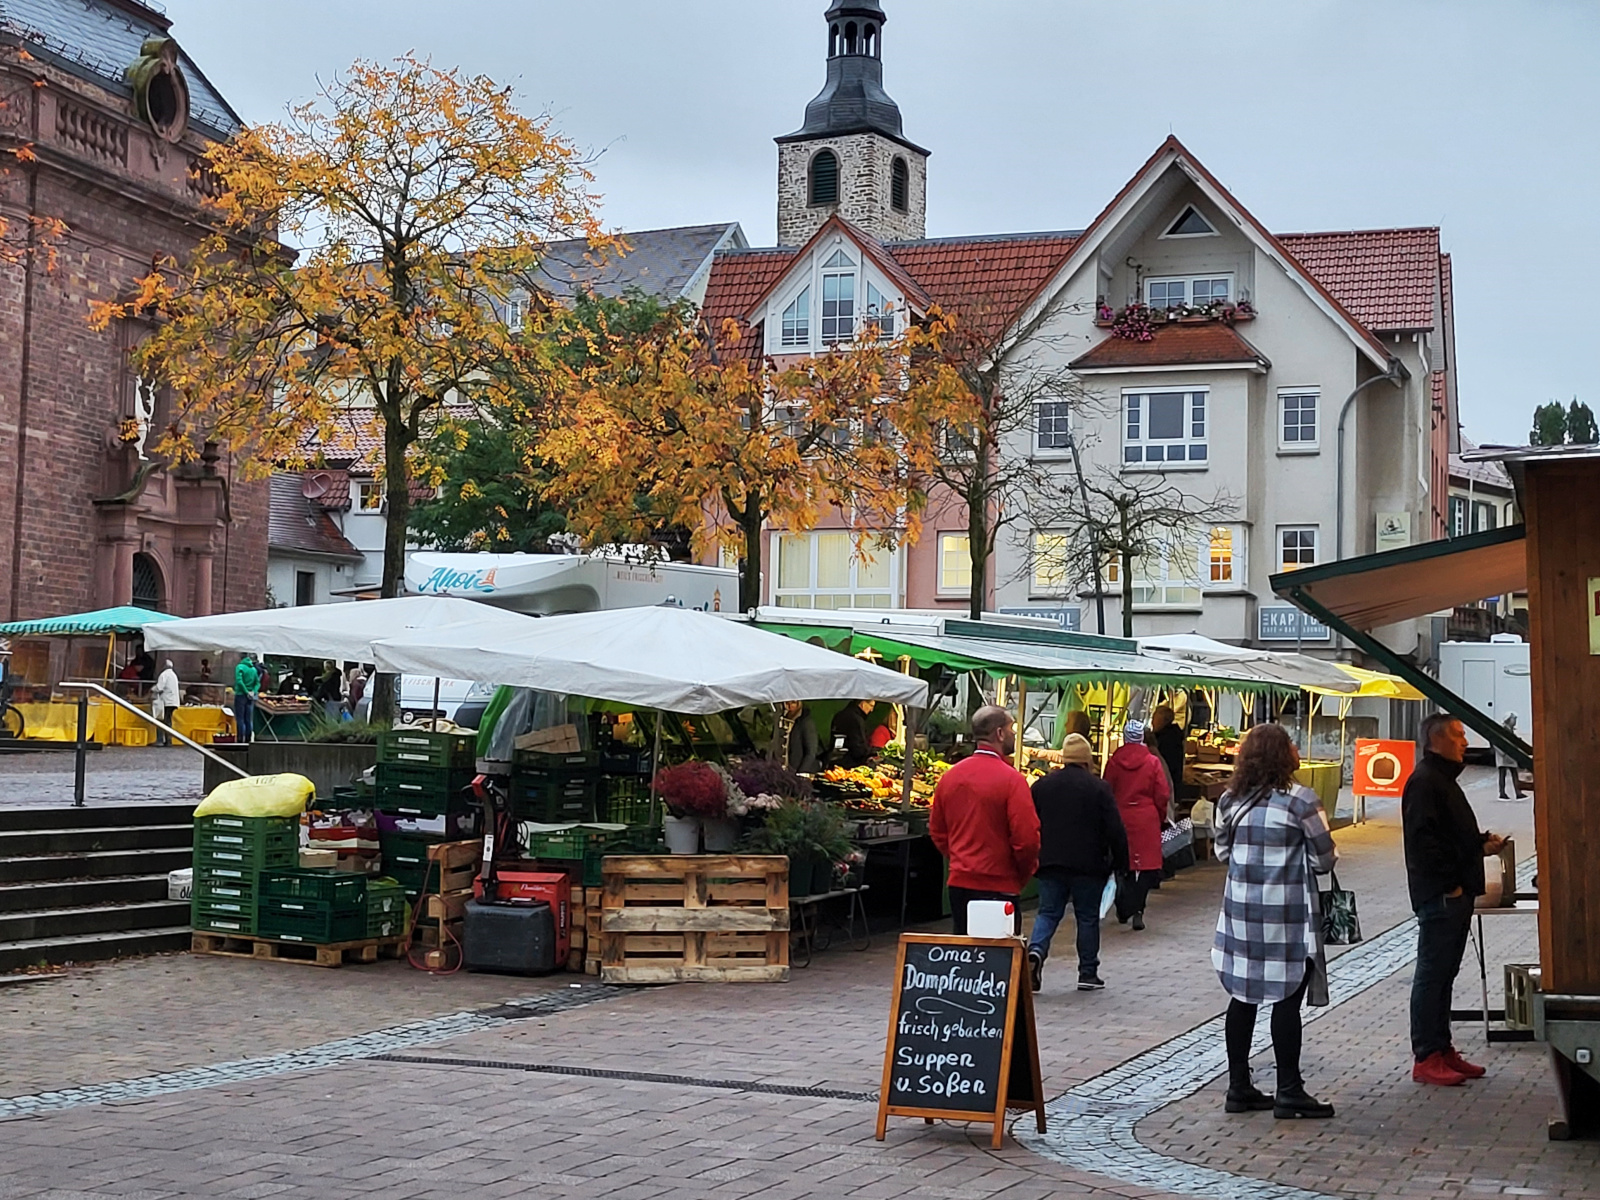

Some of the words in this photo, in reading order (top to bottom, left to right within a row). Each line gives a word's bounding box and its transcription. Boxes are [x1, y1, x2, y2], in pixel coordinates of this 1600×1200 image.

[418, 567, 484, 593] Ahoi
[928, 946, 986, 963] Oma's
[898, 1011, 938, 1041] frisch
[941, 1018, 1003, 1042] gebacken
[897, 1046, 975, 1072] Suppen
[917, 1071, 986, 1098] Soßen
